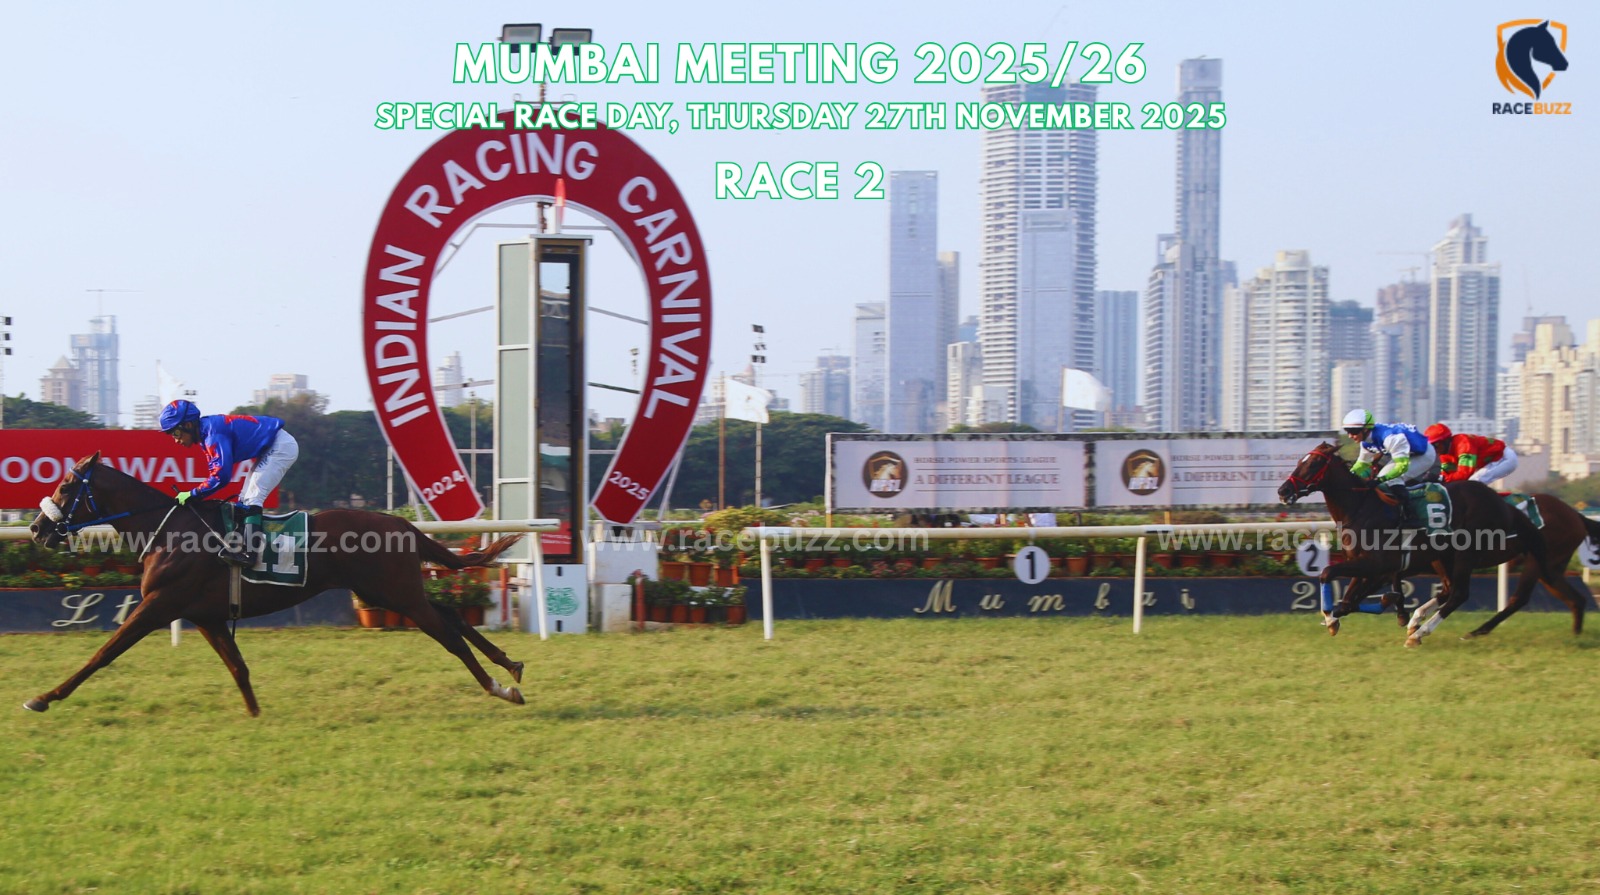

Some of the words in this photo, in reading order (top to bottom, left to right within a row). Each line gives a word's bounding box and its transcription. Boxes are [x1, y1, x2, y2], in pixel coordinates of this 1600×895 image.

[374, 245, 431, 428] INDIAN
[404, 132, 599, 228] RACING
[617, 175, 703, 420] CARNIVAL
[423, 469, 466, 502] 2024
[608, 470, 651, 501] 2025
[914, 475, 924, 484] A
[928, 474, 1004, 484] DIFFERENT
[1007, 474, 1060, 484] LEAGUE
[1171, 472, 1181, 482] A
[1184, 471, 1257, 481] DIFFERENT
[1426, 503, 1447, 528] 6
[1025, 551, 1036, 579] 1
[1305, 544, 1320, 572] 2
